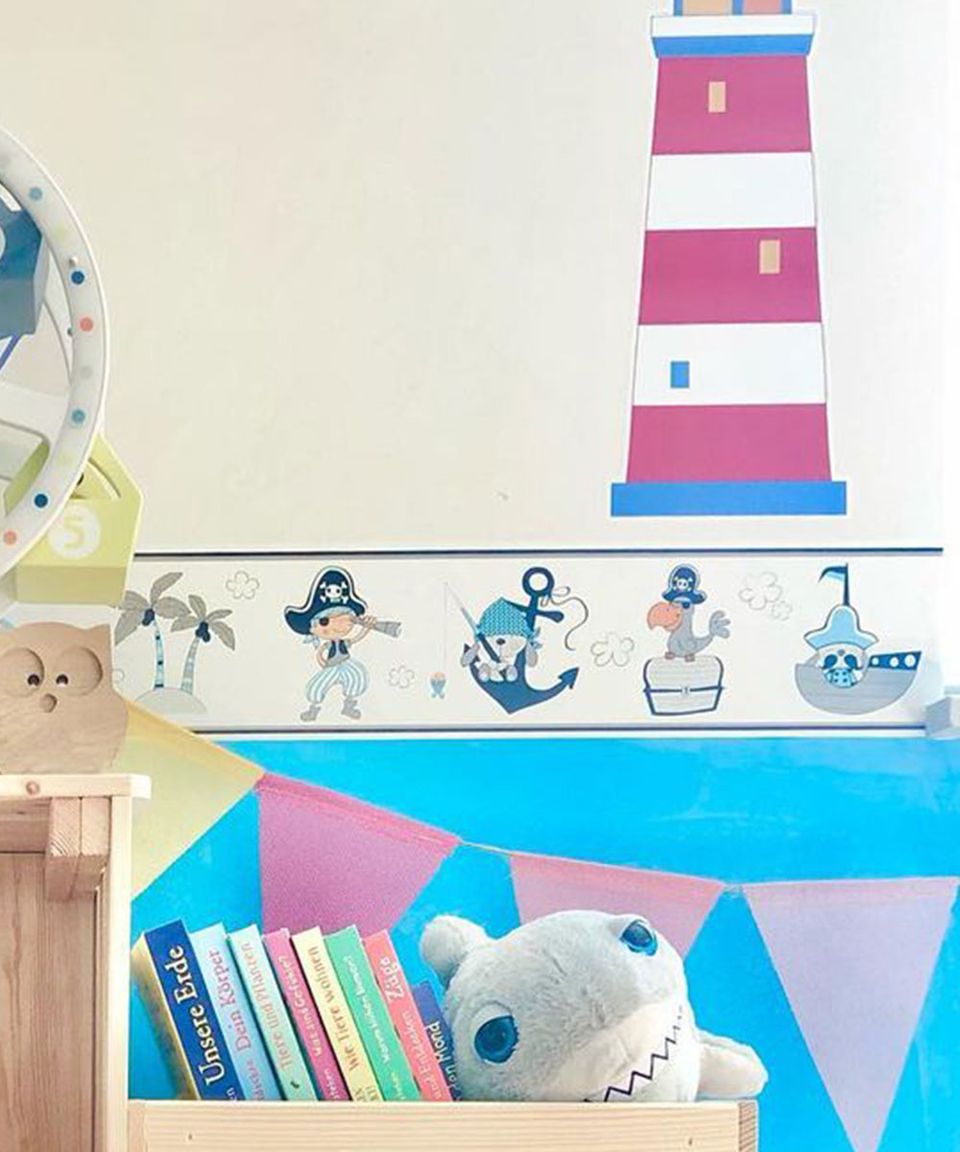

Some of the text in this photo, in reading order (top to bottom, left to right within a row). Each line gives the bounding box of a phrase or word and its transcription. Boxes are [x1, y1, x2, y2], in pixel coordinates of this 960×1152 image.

[63, 516, 85, 548] 5
[167, 946, 224, 1084] Unsere Erde
[209, 951, 252, 1052] Dein Körper
[260, 1002, 279, 1029] und
[308, 946, 359, 1071] Wie Tiere wohnen
[273, 1033, 293, 1069] Tiere
[422, 1021, 451, 1063] Mond
